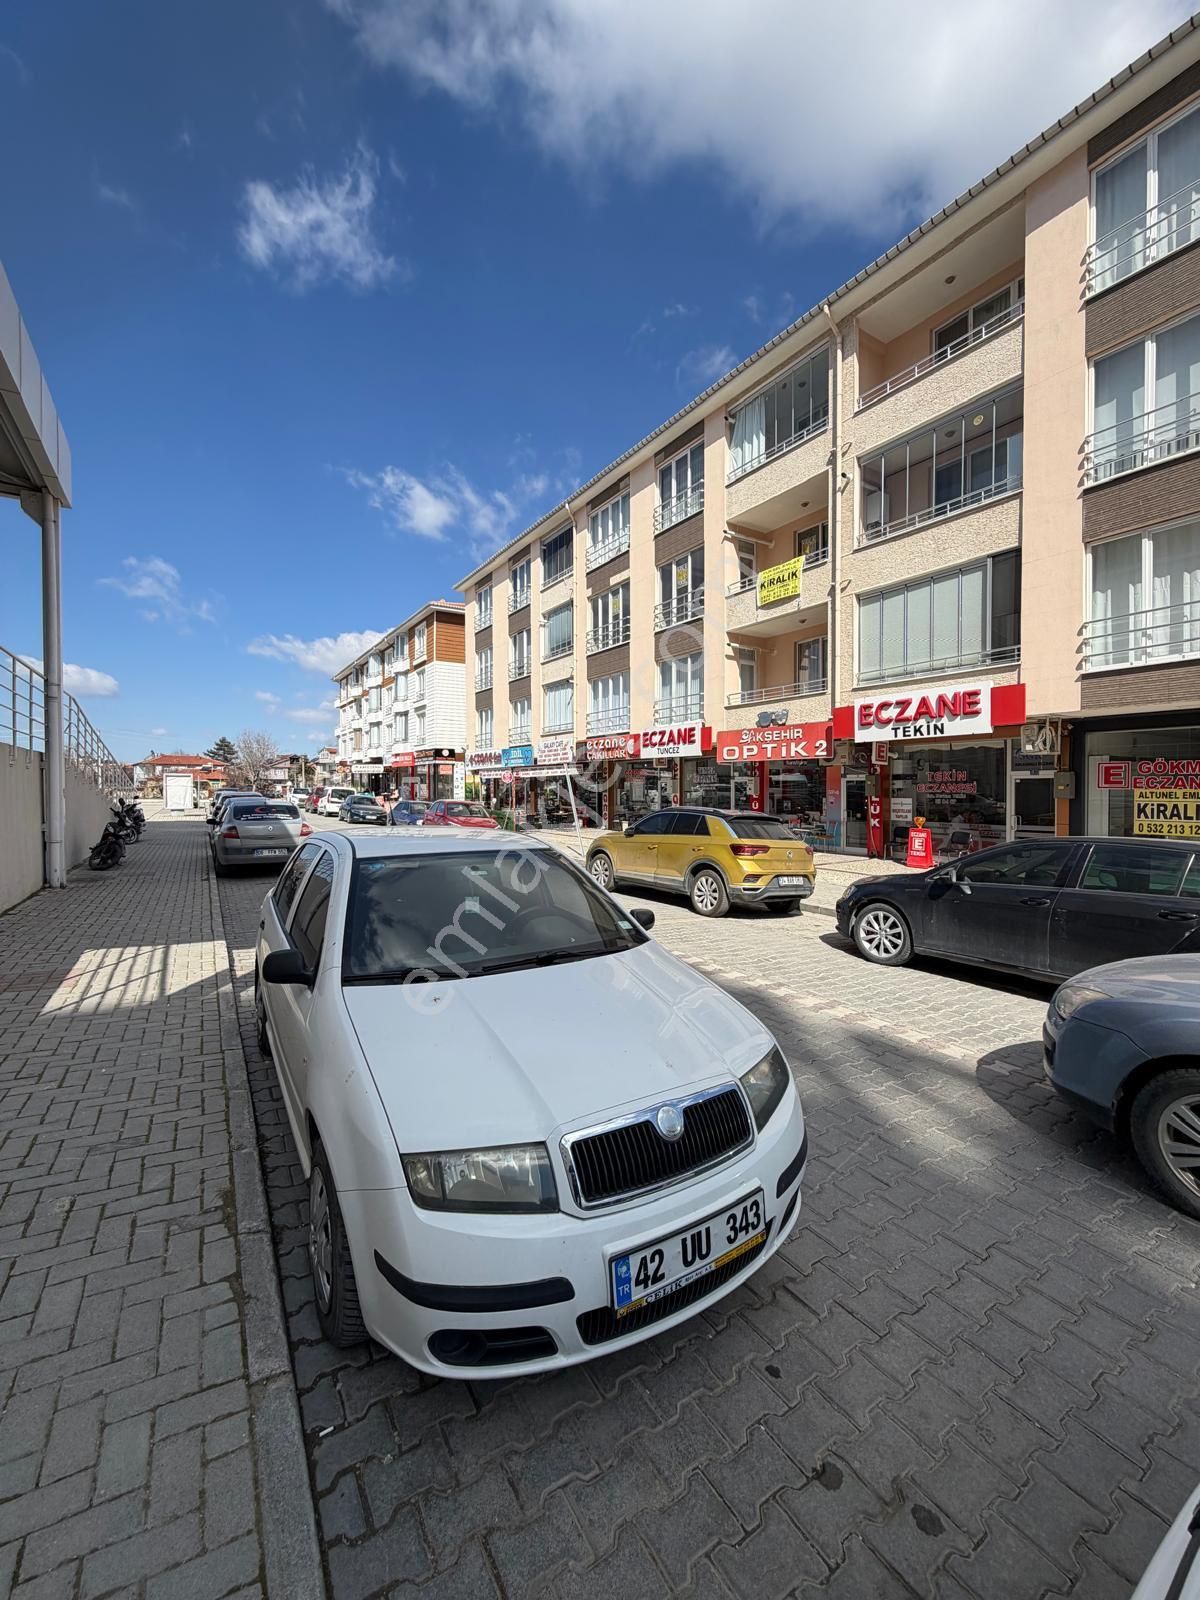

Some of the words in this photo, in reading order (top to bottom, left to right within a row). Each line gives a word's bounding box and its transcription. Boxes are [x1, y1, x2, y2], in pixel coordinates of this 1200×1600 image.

[859, 689, 982, 727] ECZANE
[642, 726, 696, 748] ECZANE
[891, 721, 945, 738] TEKİN
[586, 737, 627, 750] eczane
[815, 739, 827, 756] 2
[1138, 791, 1180, 800] ALTUNEL
[1138, 823, 1144, 833] 0
[1147, 823, 1164, 834] 532
[1167, 824, 1185, 835] 213
[634, 1249, 666, 1290] 42
[681, 1226, 711, 1268] UU
[726, 1200, 761, 1245] 343
[617, 1284, 630, 1298] TR
